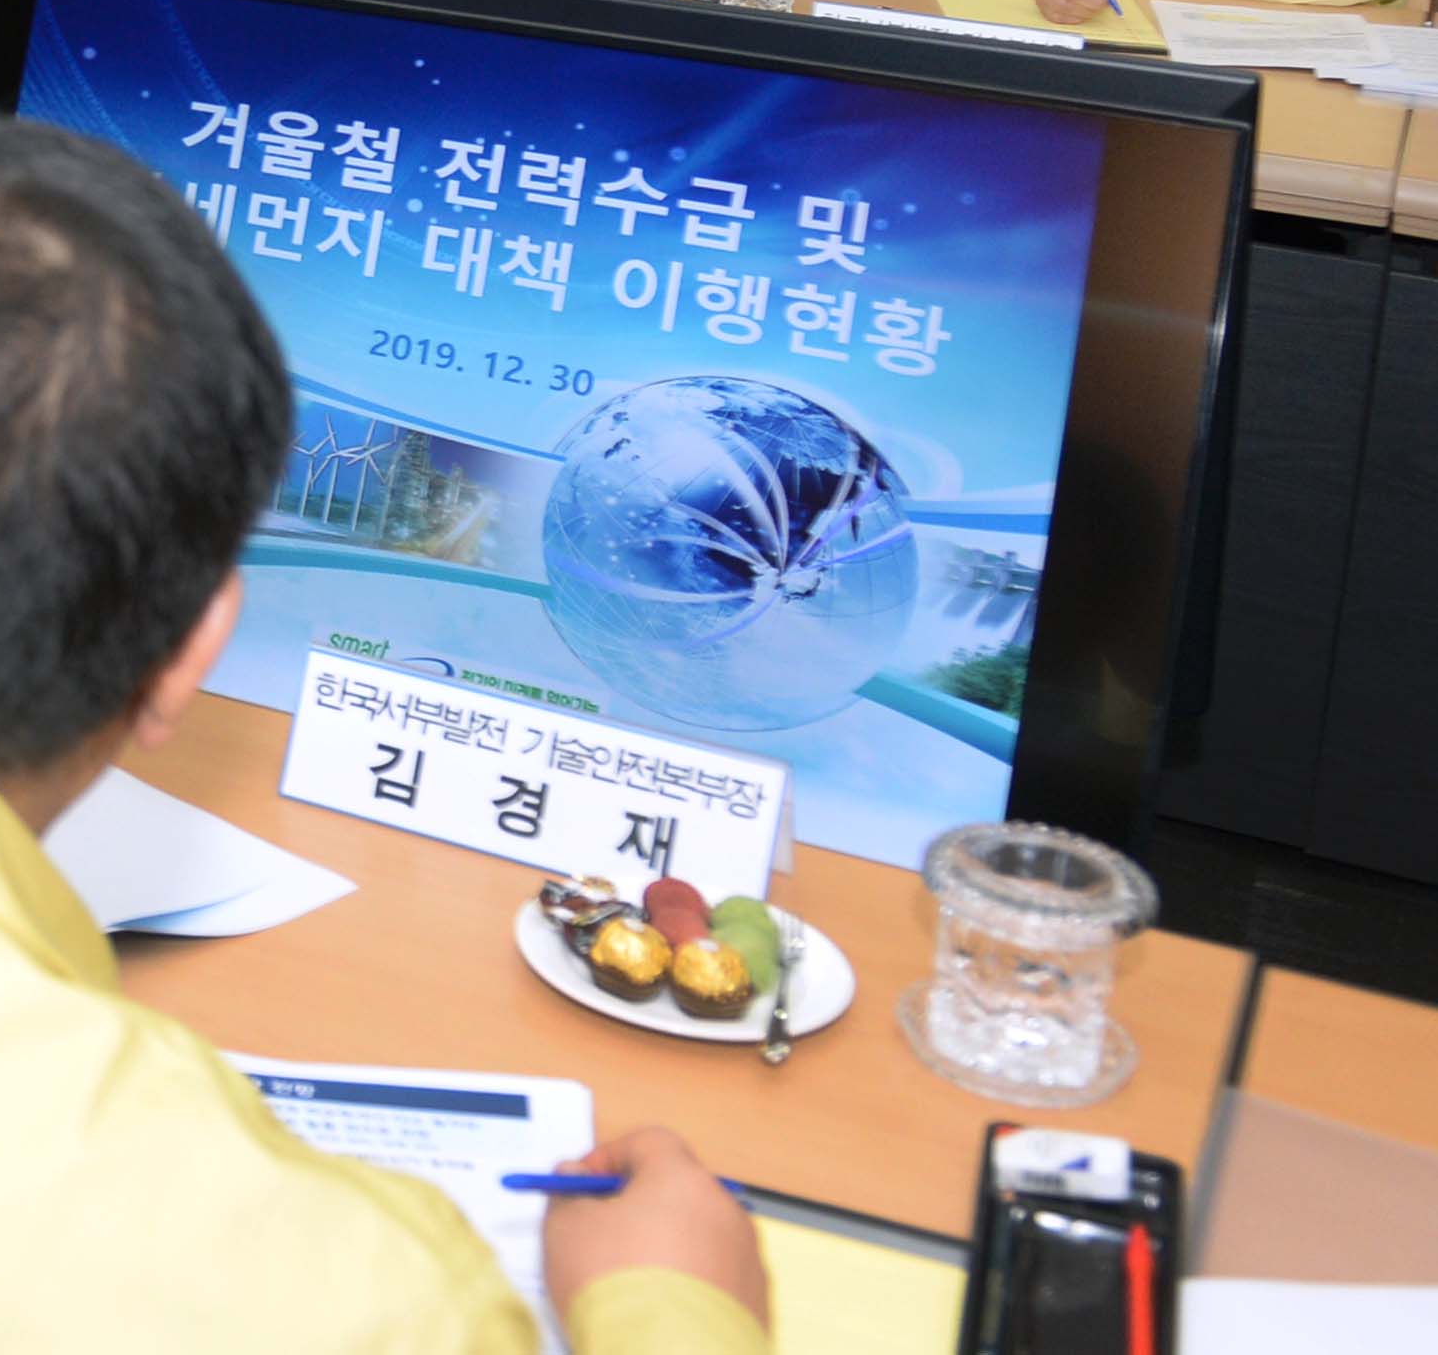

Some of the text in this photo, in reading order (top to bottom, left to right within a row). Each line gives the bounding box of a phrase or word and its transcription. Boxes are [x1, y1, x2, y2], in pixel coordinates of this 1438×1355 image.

[181, 100, 872, 276] 겨울철 전력수급 및
[184, 180, 953, 378] 세먼지 대책 이행현황
[368, 328, 596, 398] 2019. 12. 30
[329, 631, 392, 662] smart
[313, 670, 767, 823] 한국서부발전 기술안전본부장
